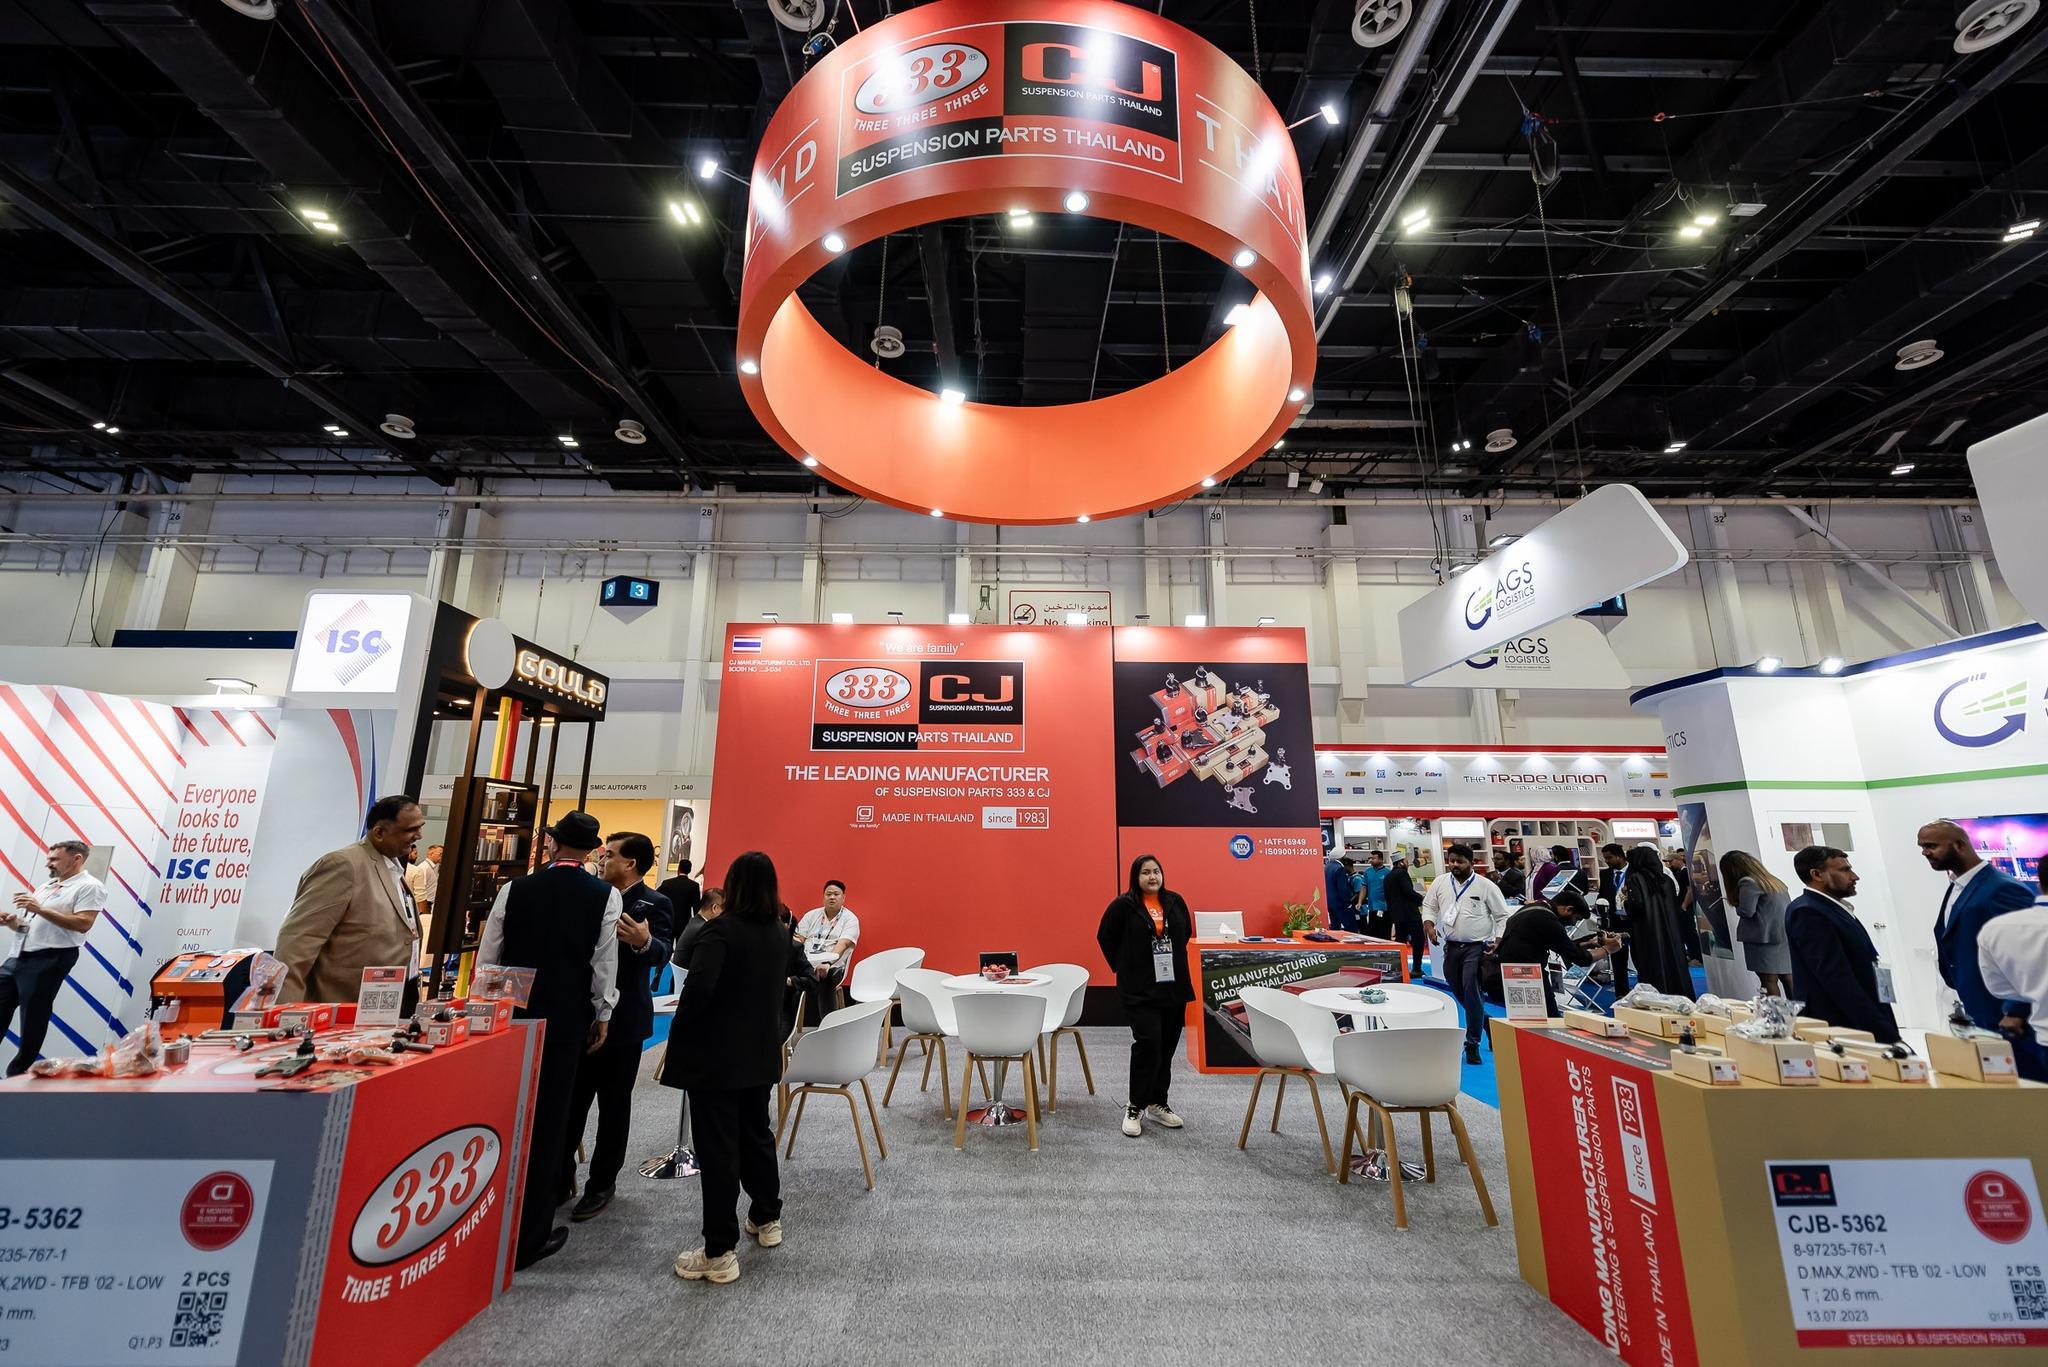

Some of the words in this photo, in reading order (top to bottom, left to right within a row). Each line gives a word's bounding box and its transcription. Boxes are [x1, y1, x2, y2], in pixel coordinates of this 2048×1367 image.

[853, 118, 889, 132] THREE
[896, 106, 938, 128] THREE
[944, 82, 989, 113] THREE
[1021, 87, 1084, 98] SUSPENSION
[1085, 93, 1116, 104] PARTS
[1117, 97, 1163, 117] THAILAND
[850, 129, 979, 178] SUSPENSION
[985, 126, 1057, 144] PARTS
[1063, 128, 1166, 162] THAILAND
[701, 508, 712, 516] 28
[1210, 512, 1221, 520] 30
[1713, 515, 1725, 523] 32
[1961, 515, 1973, 523] 33
[607, 584, 613, 597] 3
[635, 585, 644, 597] 3
[1495, 561, 1533, 600] AGS
[1495, 584, 1535, 611] LOGISTICS
[1044, 618, 1059, 626] No
[326, 629, 383, 654] ISC
[904, 645, 924, 653] are
[1503, 637, 1549, 655] AGS
[1503, 655, 1551, 664] LOGISTICS
[517, 650, 607, 704] GOULD
[838, 674, 899, 700] 333
[929, 674, 1014, 703] CJ
[824, 700, 850, 717] THREE
[854, 710, 881, 719] THREE
[884, 701, 912, 717] THREE
[822, 731, 905, 743] SUSPENSION
[908, 731, 949, 743] PARTS
[952, 732, 1014, 743] THAILAND
[785, 765, 820, 781] THE
[823, 765, 901, 781] LEADING
[905, 765, 1050, 782] MANUFACTURER
[183, 783, 257, 809] Everyone
[875, 787, 890, 797] OF
[893, 787, 965, 797] SUSPENSION
[967, 787, 1003, 797] PARTS
[1006, 787, 1025, 797] 333
[1027, 788, 1035, 797] &
[1036, 788, 1050, 798] CJ
[177, 808, 220, 828] looks
[223, 810, 239, 828] to
[882, 813, 911, 822] MADE
[913, 813, 924, 822] IN
[926, 813, 974, 822] THAILAND
[987, 812, 1013, 824] since
[1017, 812, 1045, 824] 1983
[172, 832, 198, 853] the
[200, 832, 251, 857] future,
[1264, 838, 1306, 846] IATF16949
[166, 858, 211, 880] ISC
[159, 882, 172, 904] it
[175, 883, 209, 904] with
[209, 888, 242, 909] you
[176, 928, 212, 937] QUALITY
[181, 943, 200, 951] AND
[1211, 977, 1226, 990] CJ
[1229, 954, 1328, 987] MANUFACTURING
[1214, 988, 1241, 1002] MADE
[1254, 971, 1303, 989] THAILAND
[1566, 1058, 1582, 1092] OF
[1581, 1066, 1598, 1120] PARTS
[1618, 1086, 1641, 1135] 1983
[1630, 1144, 1648, 1190] since
[1589, 1121, 1615, 1234] SUSPENSION
[1776, 1172, 1831, 1193] CJ
[376, 1135, 485, 1250] 333
[1572, 1095, 1612, 1284] MANUFACTURER
[1788, 1214, 1888, 1234] CJB-5362
[340, 1274, 393, 1304] THREE
[399, 1241, 448, 1290] THREE
[454, 1186, 496, 1248] THREE
[1606, 1238, 1617, 1249] &
[1793, 1243, 1887, 1257] 8-97235-767-1
[182, 1272, 193, 1287] 2
[196, 1272, 230, 1287] PCS
[1891, 1265, 1919, 1279] TFB
[1922, 1264, 1942, 1279] '02
[1953, 1264, 1987, 1278] LOW
[2007, 1266, 2014, 1276] 2
[2016, 1266, 2041, 1277] PCS
[61, 1275, 89, 1290] TFB
[94, 1275, 115, 1290] '02
[127, 1275, 164, 1290] LOW
[1609, 1253, 1632, 1346] STEERING
[1802, 1289, 1810, 1301] T
[1823, 1288, 1851, 1302] 20.6
[1855, 1290, 1884, 1302] mm.
[1654, 1309, 1668, 1331] IN
[1807, 1310, 1869, 1323] 13.07.2023
[128, 1336, 163, 1349] Q1.P3
[1848, 1333, 1904, 1345] STEERING
[1906, 1333, 1915, 1345] &
[1916, 1332, 1988, 1345] SUSPENSION
[1990, 1332, 2026, 1345] PARTS
